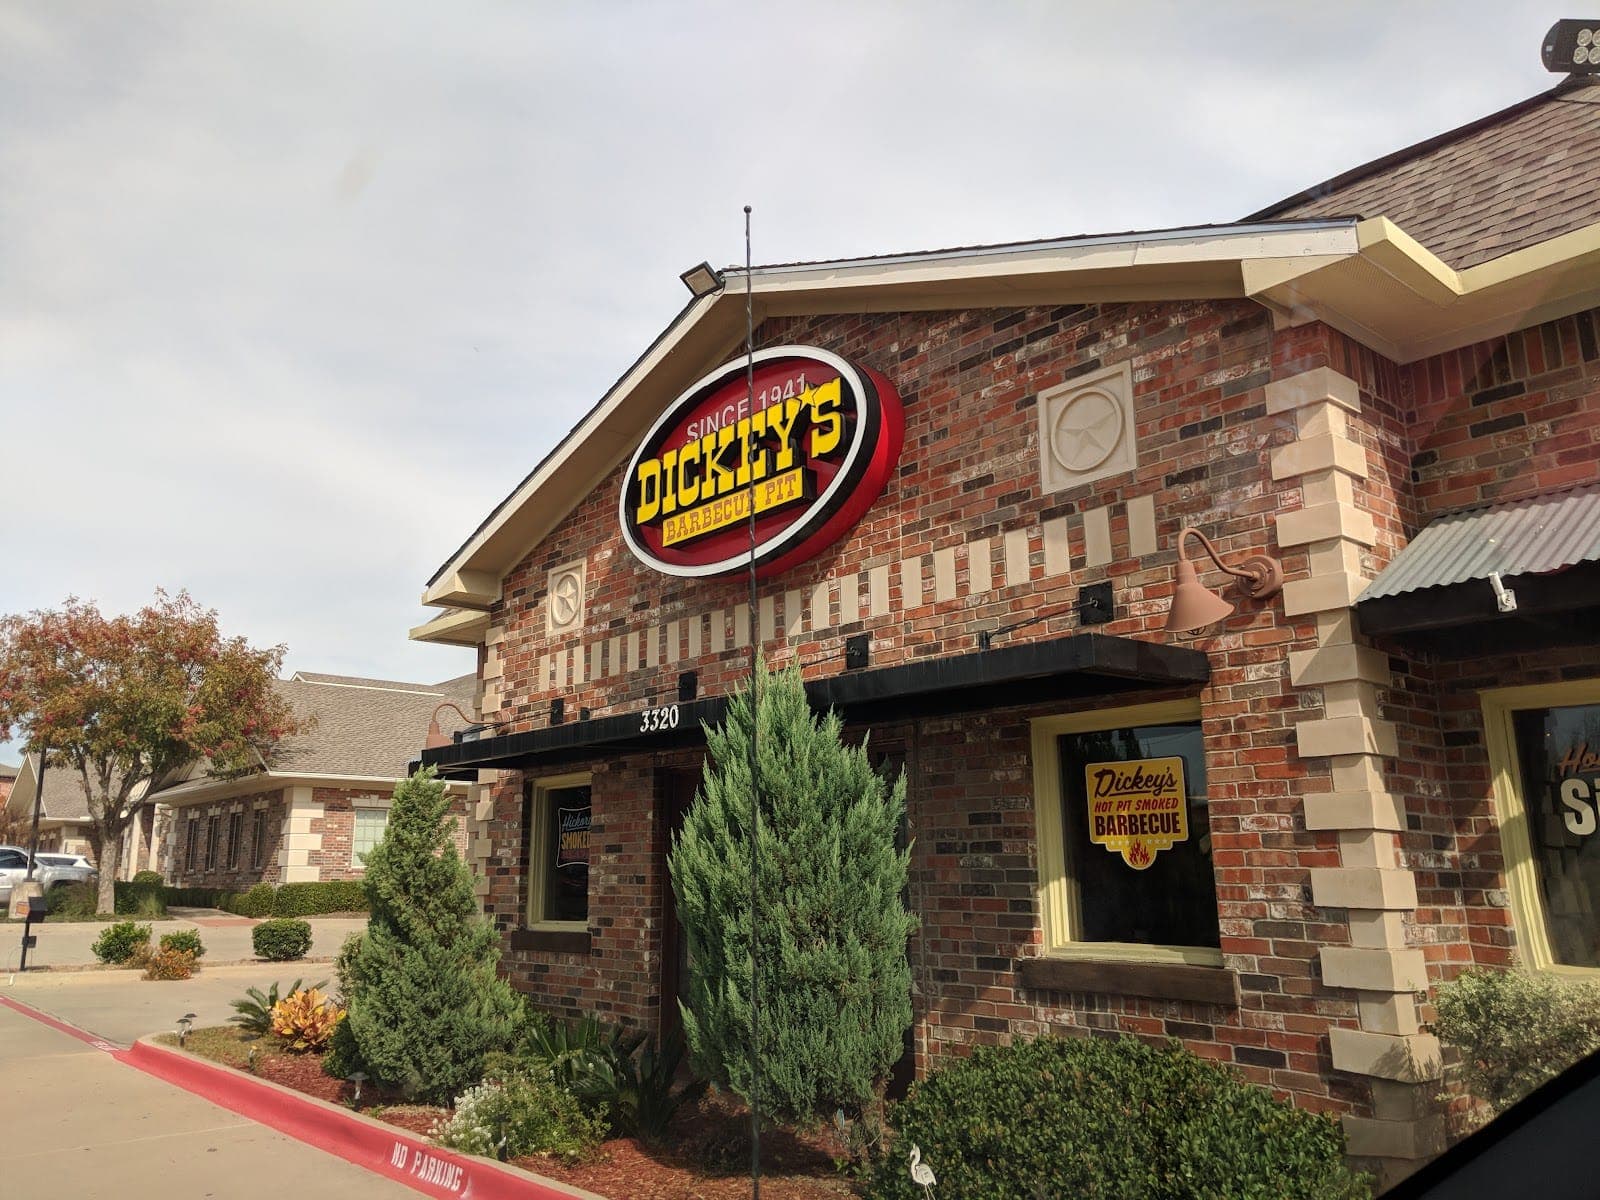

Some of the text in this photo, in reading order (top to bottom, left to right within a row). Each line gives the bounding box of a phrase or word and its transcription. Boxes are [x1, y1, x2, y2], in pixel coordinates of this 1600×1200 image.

[686, 373, 805, 443] SINCE 1941
[637, 377, 841, 524] DICKEY'S
[765, 474, 796, 505] PIT
[640, 705, 679, 732] 3320
[1094, 765, 1177, 798] Dickey's
[1095, 798, 1179, 813] HOT PIT SMOKED
[1095, 812, 1181, 836] BARBECUE
[391, 1141, 463, 1192] NO PARKING
